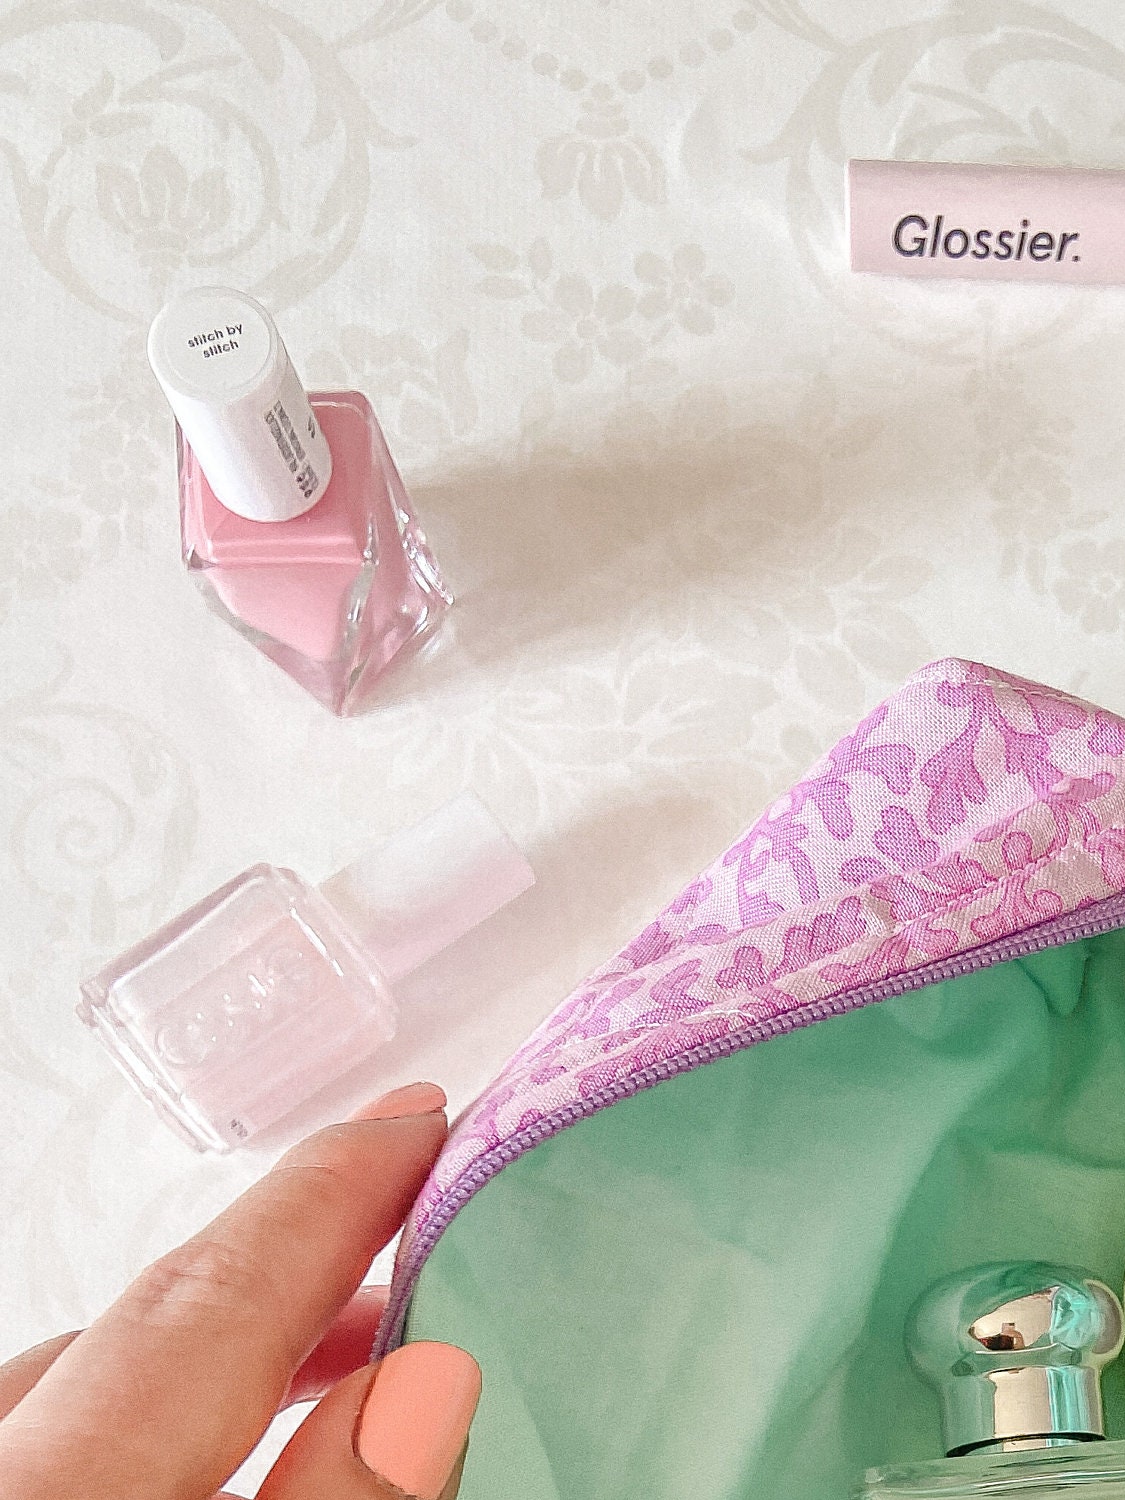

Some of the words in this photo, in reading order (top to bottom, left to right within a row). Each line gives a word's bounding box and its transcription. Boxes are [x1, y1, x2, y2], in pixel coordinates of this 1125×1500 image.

[893, 214, 1081, 262] Glossier.
[187, 328, 223, 348] stitch
[225, 323, 243, 335] by
[203, 339, 239, 358] stitch
